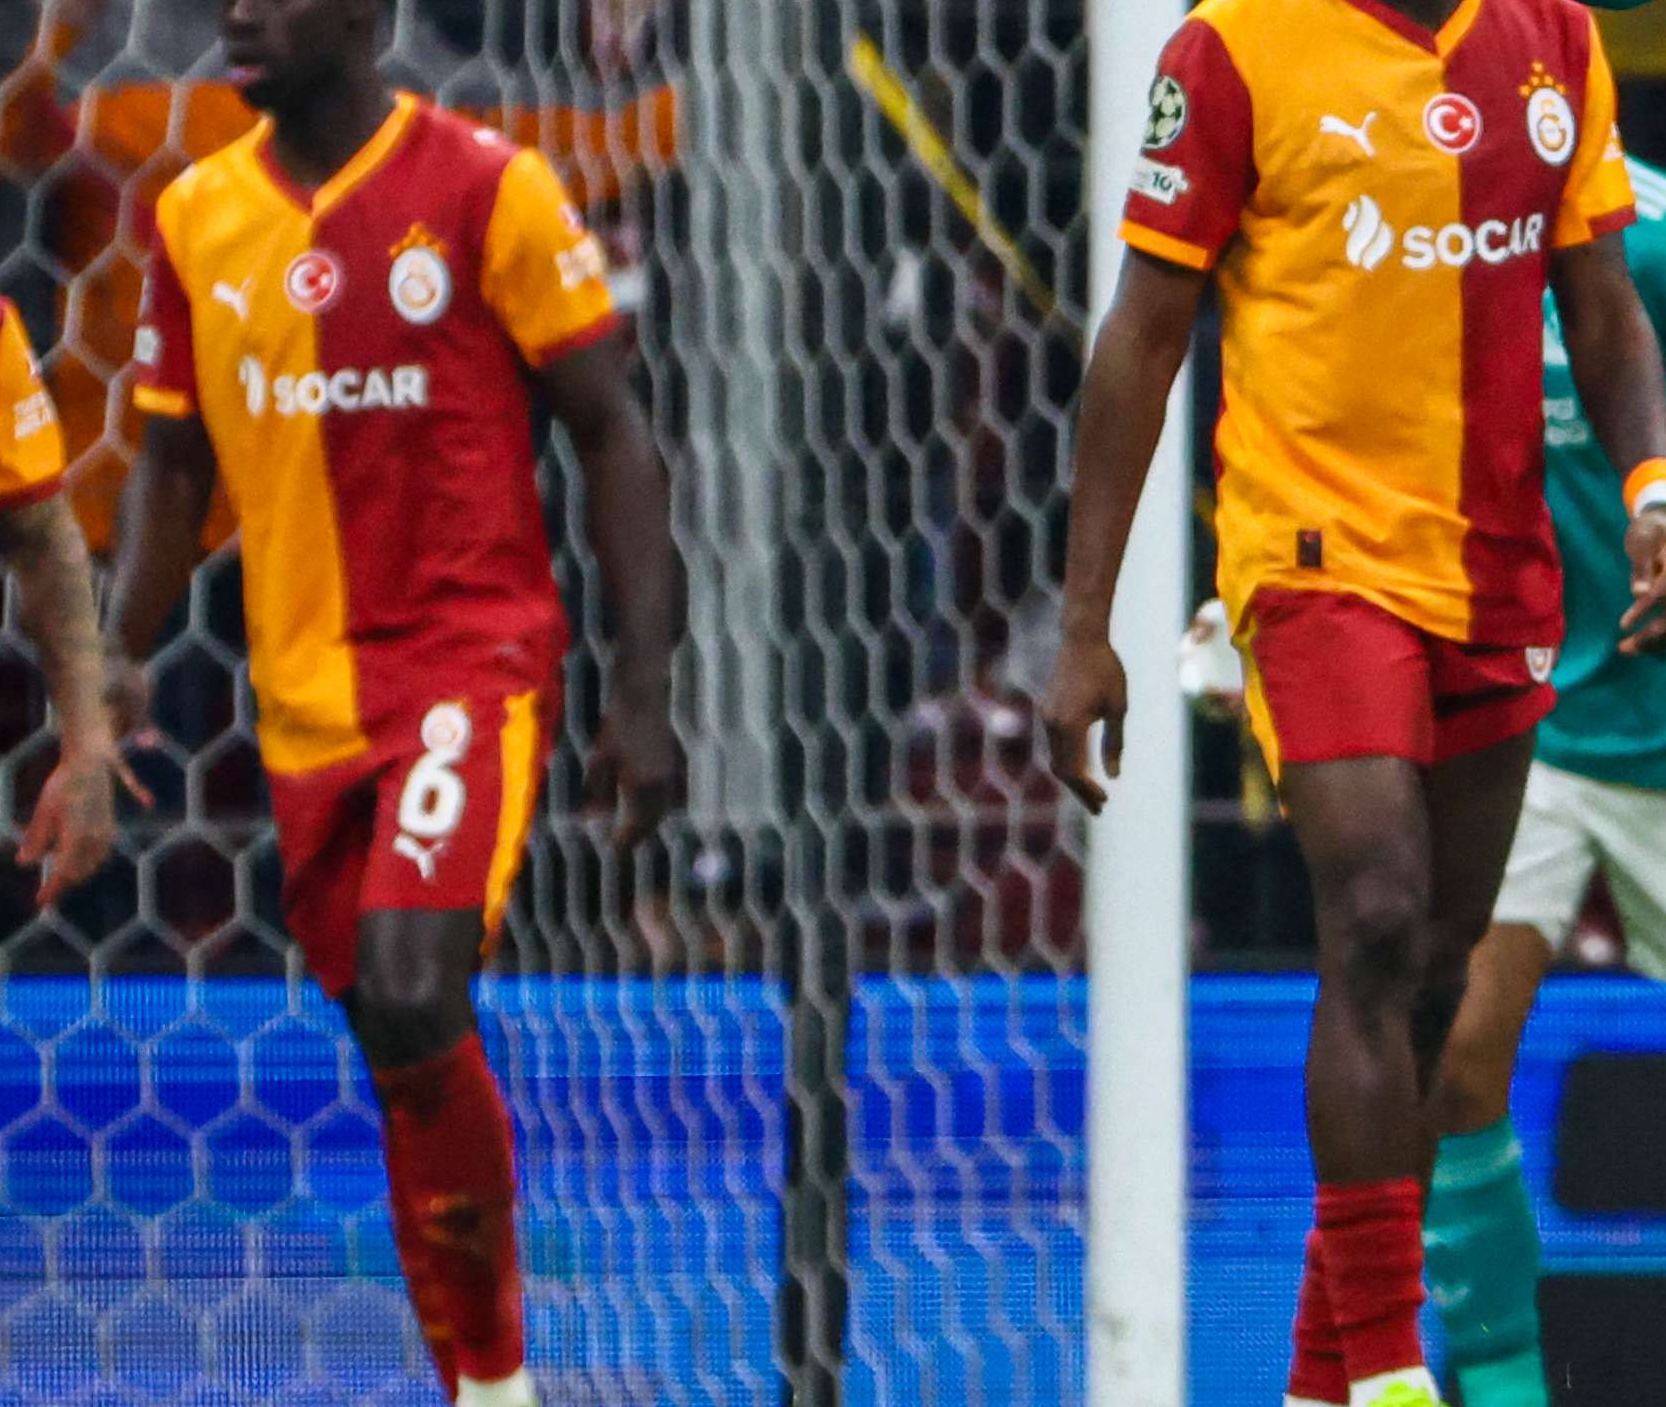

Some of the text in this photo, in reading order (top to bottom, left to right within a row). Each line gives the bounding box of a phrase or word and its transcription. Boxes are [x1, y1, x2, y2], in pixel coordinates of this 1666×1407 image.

[1401, 212, 1545, 271] SOCAR
[273, 363, 429, 418] SOCAR
[398, 752, 468, 837] 6
